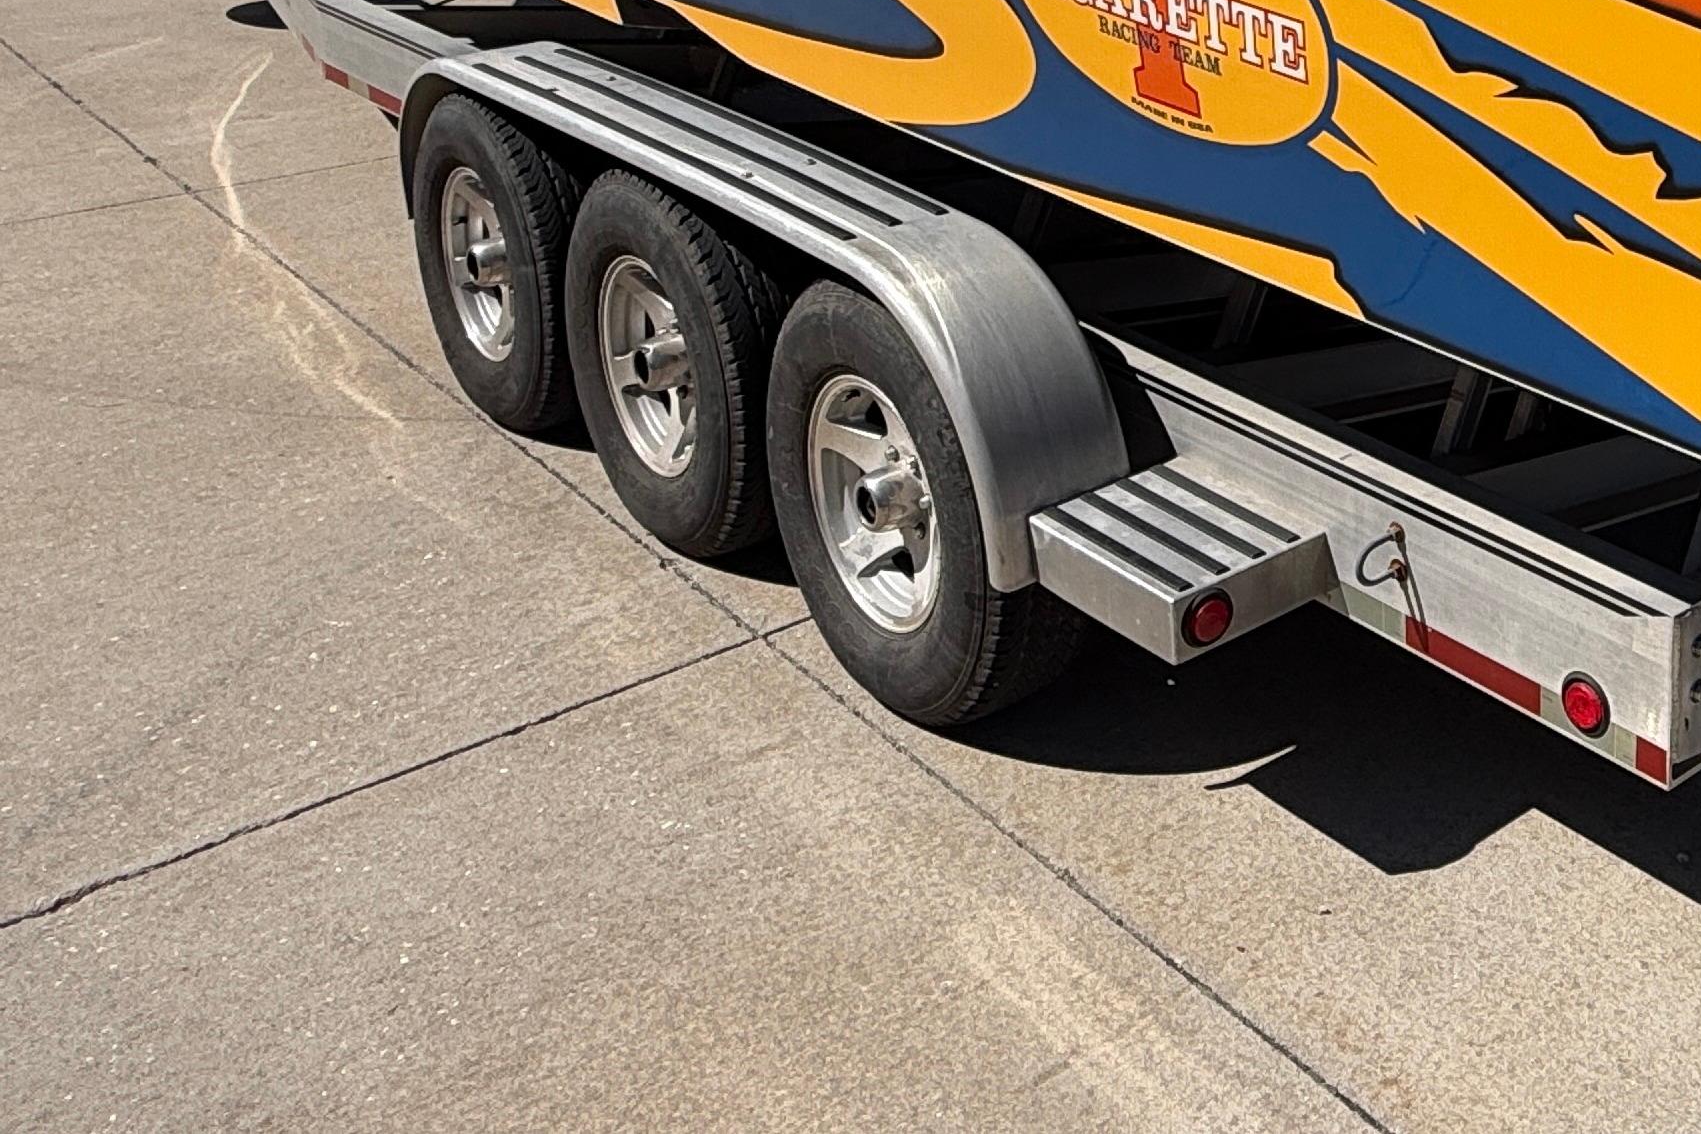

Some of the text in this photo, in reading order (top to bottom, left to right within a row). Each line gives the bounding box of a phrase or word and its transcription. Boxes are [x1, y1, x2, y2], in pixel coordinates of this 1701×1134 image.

[1098, 15, 1222, 76] RACING TEAM
[1131, 96, 1213, 133] MADE IN USA
